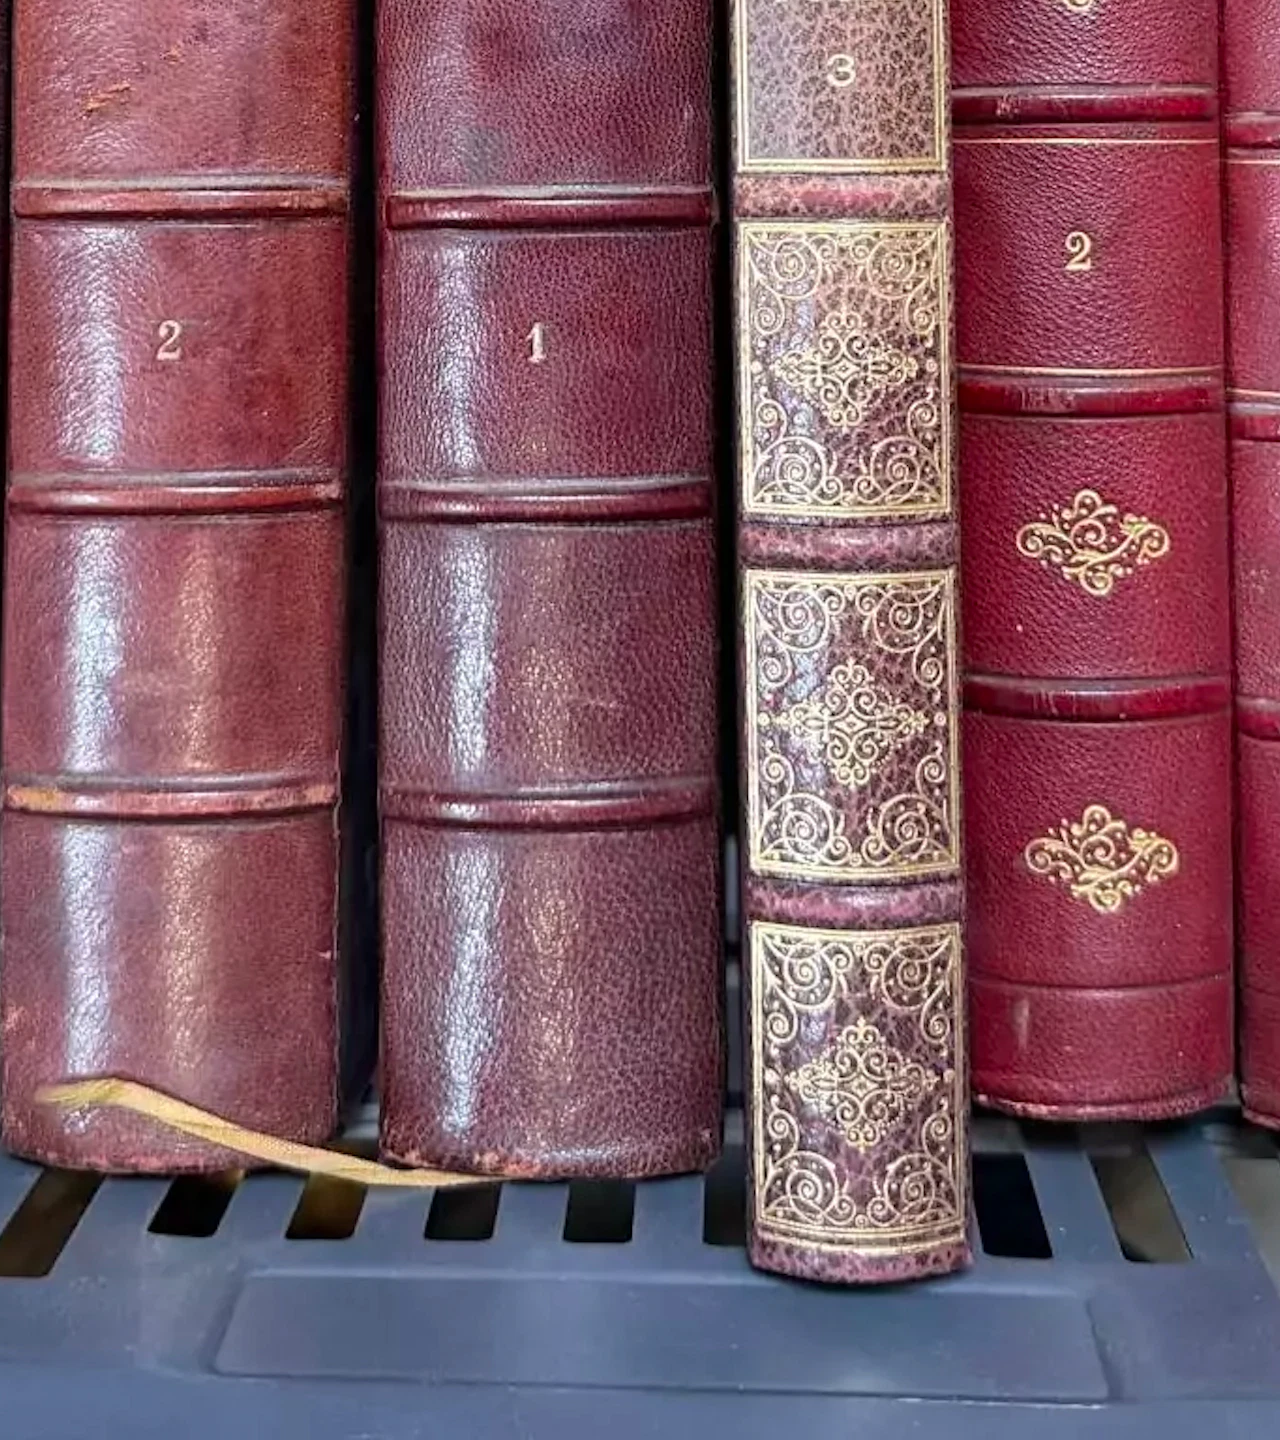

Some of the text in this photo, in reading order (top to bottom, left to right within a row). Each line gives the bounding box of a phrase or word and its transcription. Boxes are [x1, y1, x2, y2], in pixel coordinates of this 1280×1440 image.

[827, 54, 856, 87] 3
[1065, 231, 1092, 271] 2
[155, 320, 183, 361] 2
[525, 324, 547, 362] 1
